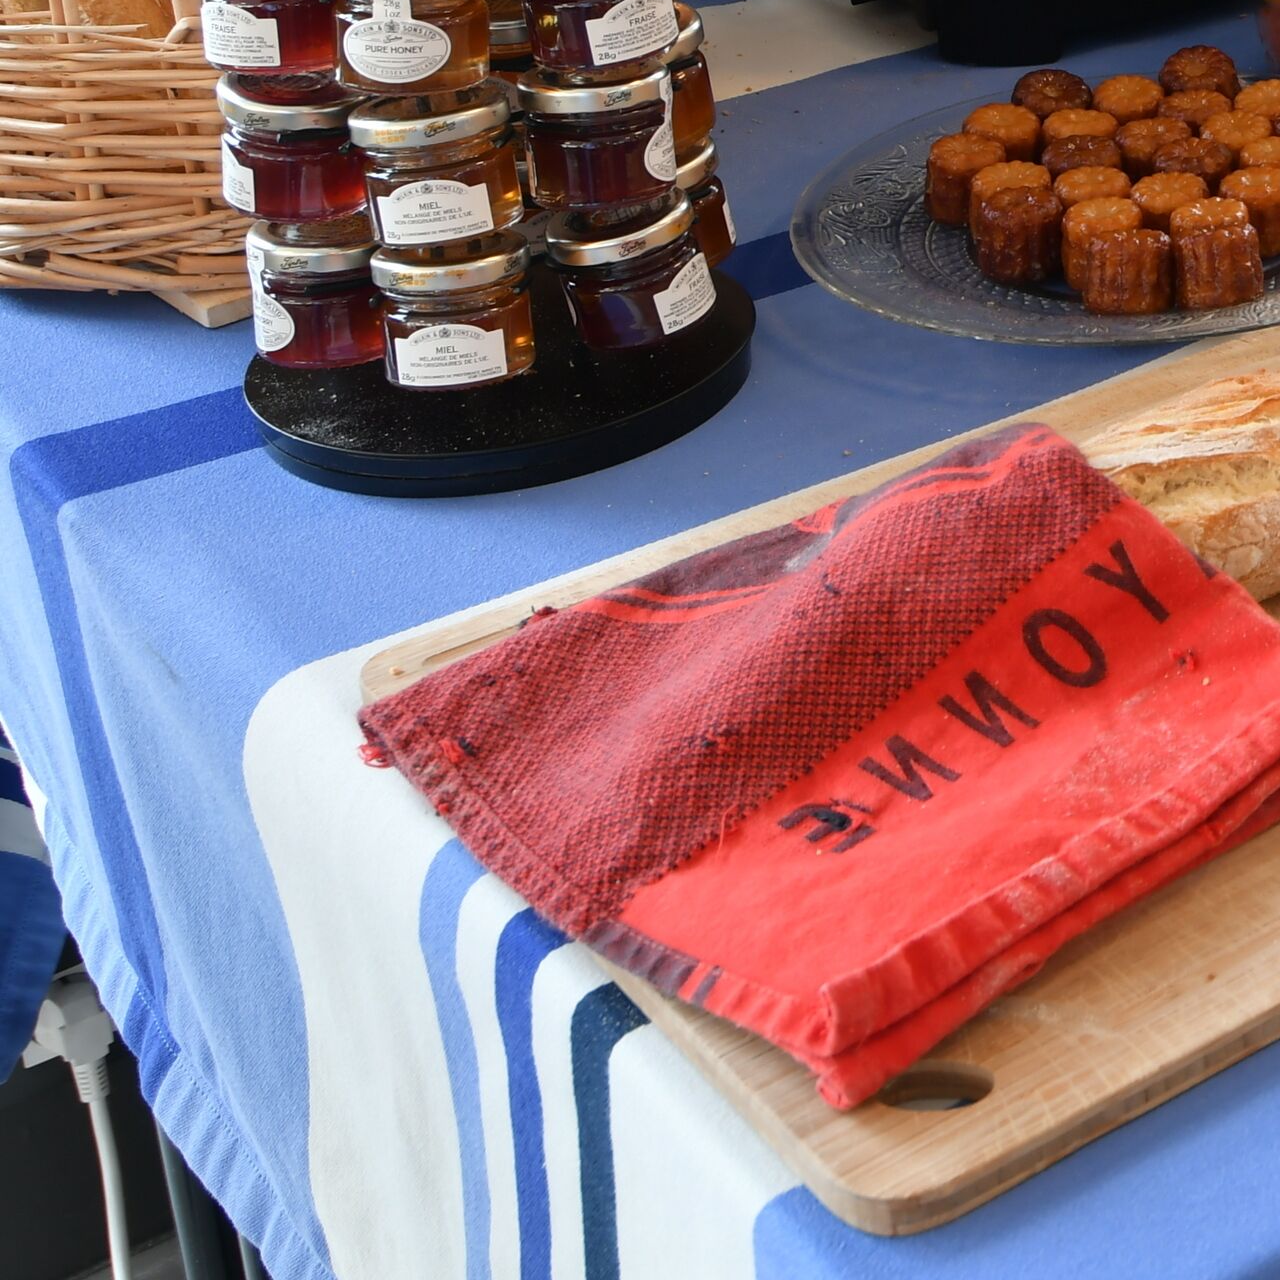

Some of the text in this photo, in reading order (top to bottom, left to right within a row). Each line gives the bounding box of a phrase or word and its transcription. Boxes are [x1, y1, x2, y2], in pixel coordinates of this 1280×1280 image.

[383, 0, 400, 9] 28g
[384, 9, 401, 18] 1oz
[629, 11, 657, 27] FRAISE
[211, 23, 237, 34] FRAISE
[403, 25, 422, 34] SONS
[365, 44, 424, 54] PURE HONEY
[418, 201, 443, 210] MIEL
[443, 207, 463, 215] MIELS
[386, 231, 401, 240] 28g
[436, 346, 458, 354] MIEL
